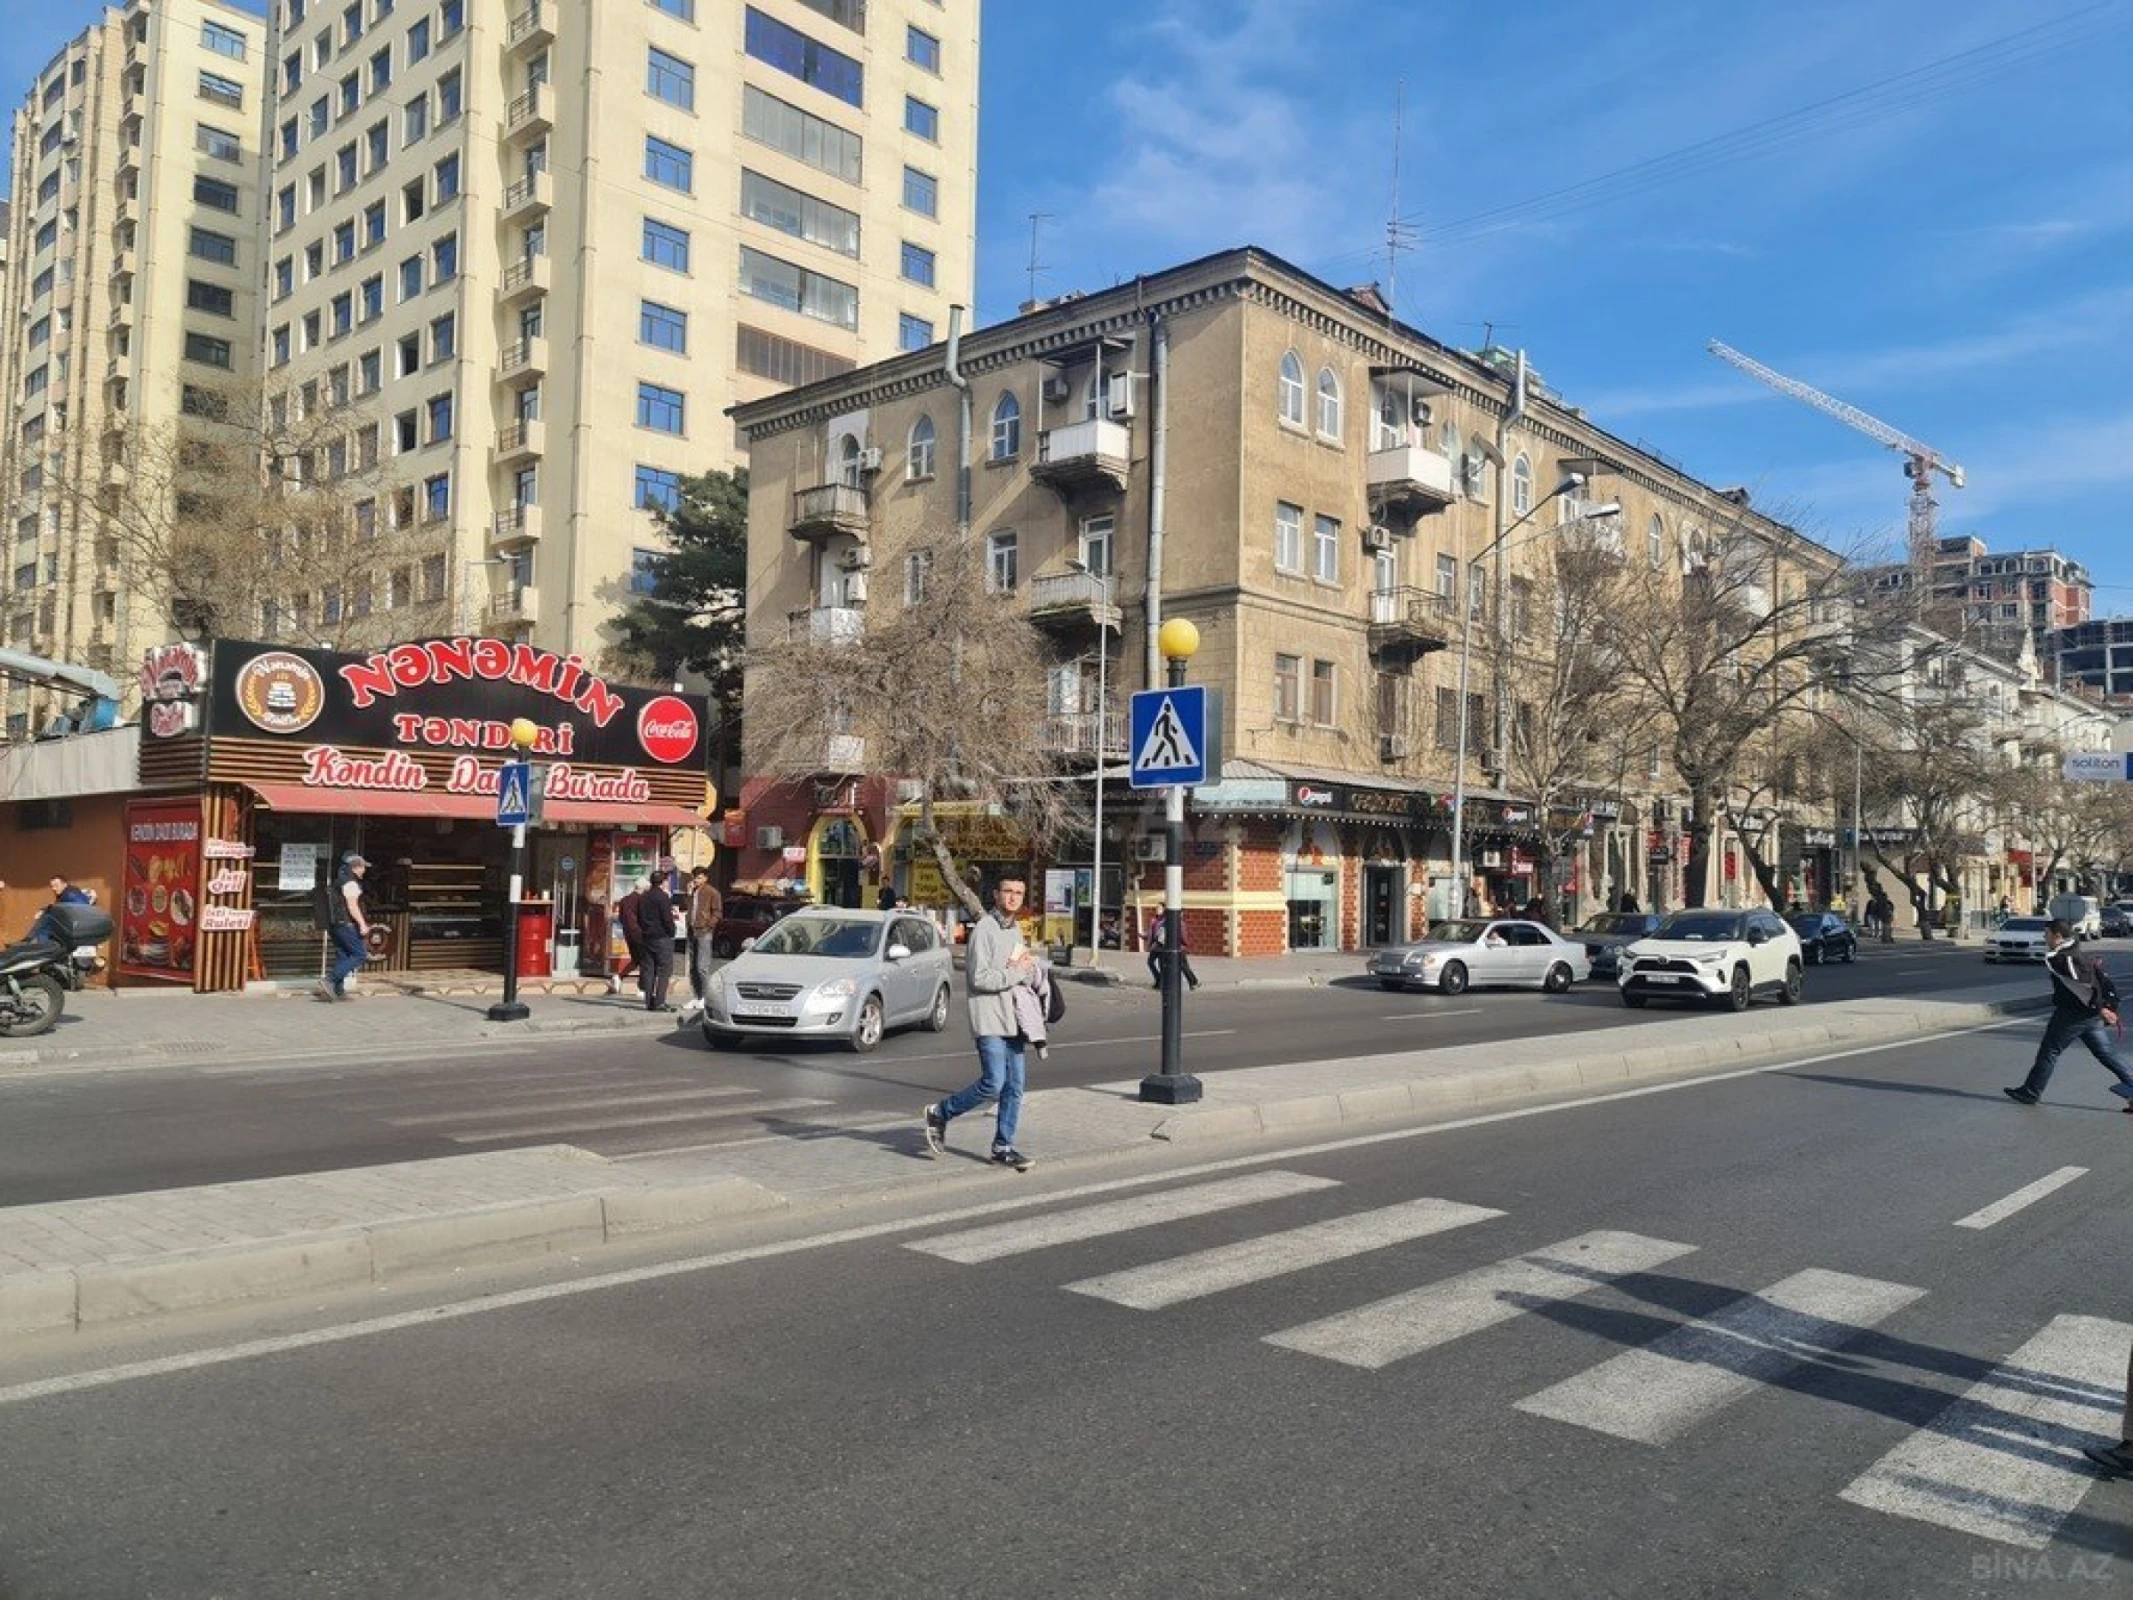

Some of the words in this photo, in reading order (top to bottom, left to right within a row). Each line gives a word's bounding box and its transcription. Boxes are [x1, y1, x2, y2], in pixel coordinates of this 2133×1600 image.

[339, 637, 625, 728] NƏNƏMİN
[393, 713, 574, 755] TƏNDRİ
[303, 745, 428, 790] Kəndin
[543, 761, 649, 802] Burada
